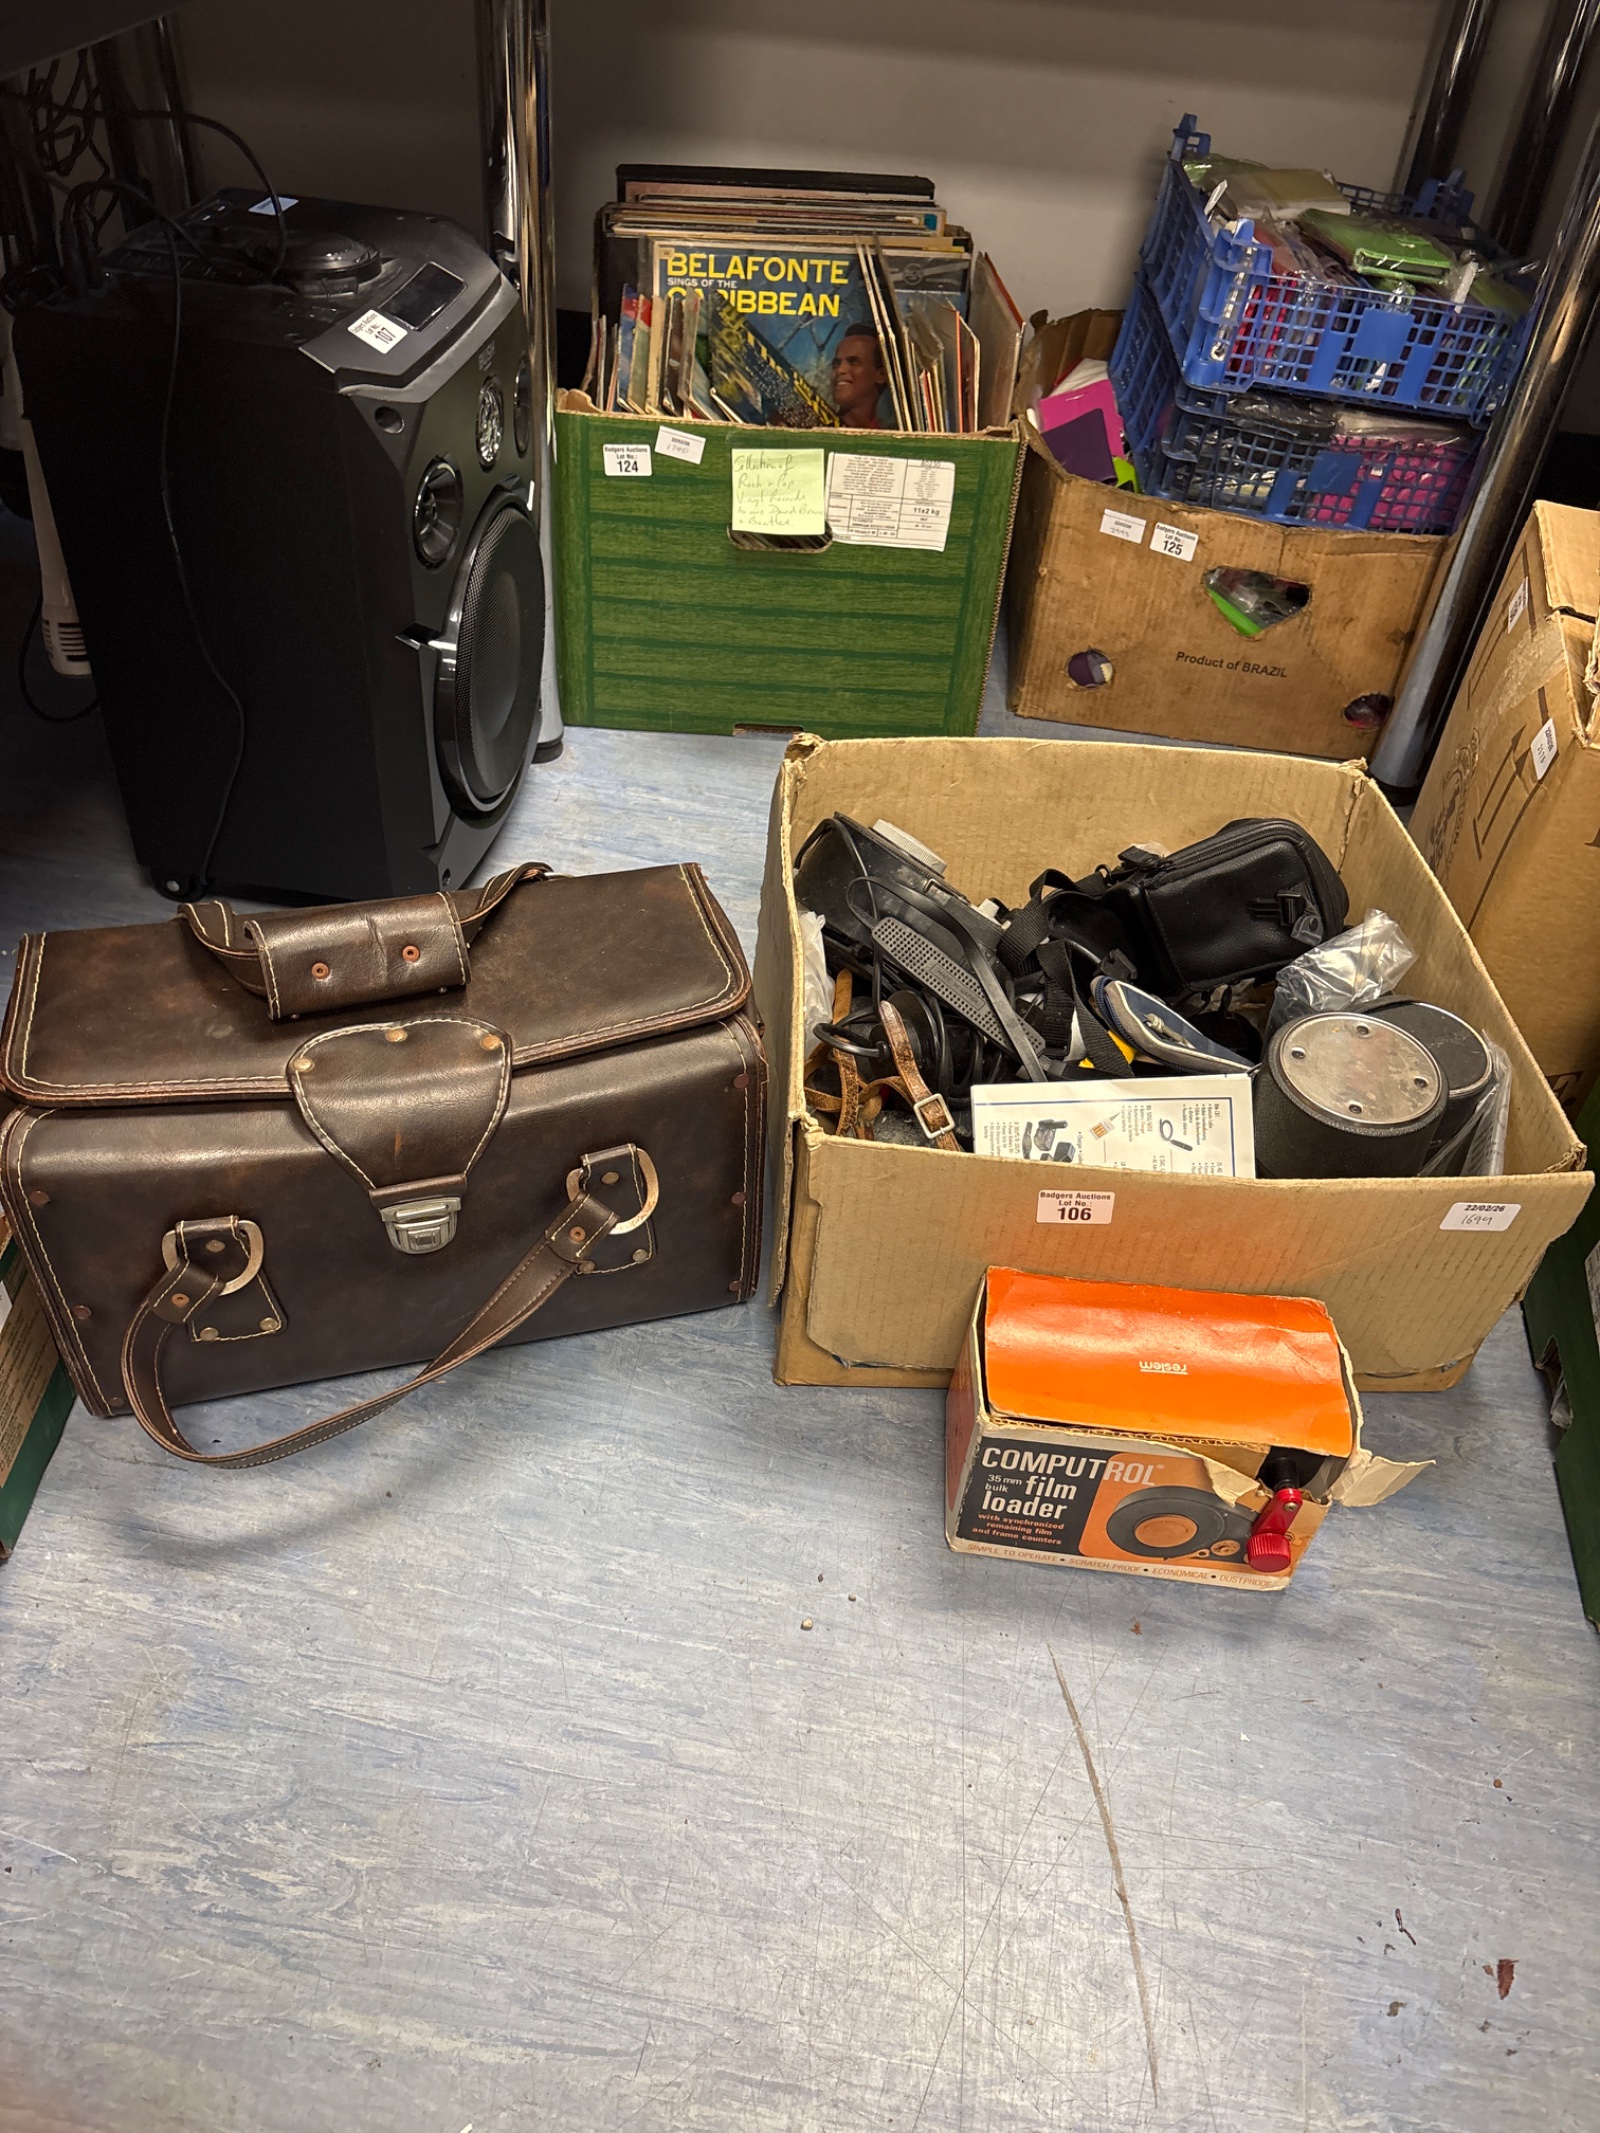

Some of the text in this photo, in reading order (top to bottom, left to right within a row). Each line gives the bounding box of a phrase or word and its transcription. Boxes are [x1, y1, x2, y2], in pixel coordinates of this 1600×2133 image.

[667, 253, 849, 284] BELAFONTE
[667, 277, 737, 289] SINGS OF THE
[667, 287, 840, 317] IBBEAN
[374, 327, 396, 344] 107
[617, 460, 639, 473] 124
[931, 508, 940, 516] kg
[1162, 540, 1183, 556] 125
[1175, 651, 1287, 678] Product of BRAZIL
[1040, 1191, 1111, 1200] Badgers Auctions
[1057, 1207, 1092, 1221] 106
[1464, 1204, 1506, 1212] 22/02/26
[984, 1482, 1009, 1493] bulk
[987, 1474, 1022, 1485] 35 mm
[1024, 1475, 1078, 1500] film
[981, 1491, 1068, 1519] loader
[977, 1513, 1064, 1530] with synchronized
[986, 1521, 1053, 1536] remaining film
[972, 1526, 1062, 1545] and frame counters
[966, 1544, 999, 1555] SIMPLE
[1017, 1551, 1058, 1563] OPERATE
[1068, 1557, 1110, 1569] SCRATCH
[1111, 1563, 1141, 1572] PROOF
[1152, 1567, 1209, 1579] ECONOMICAL
[1219, 1574, 1272, 1588] DUSTPROOF
